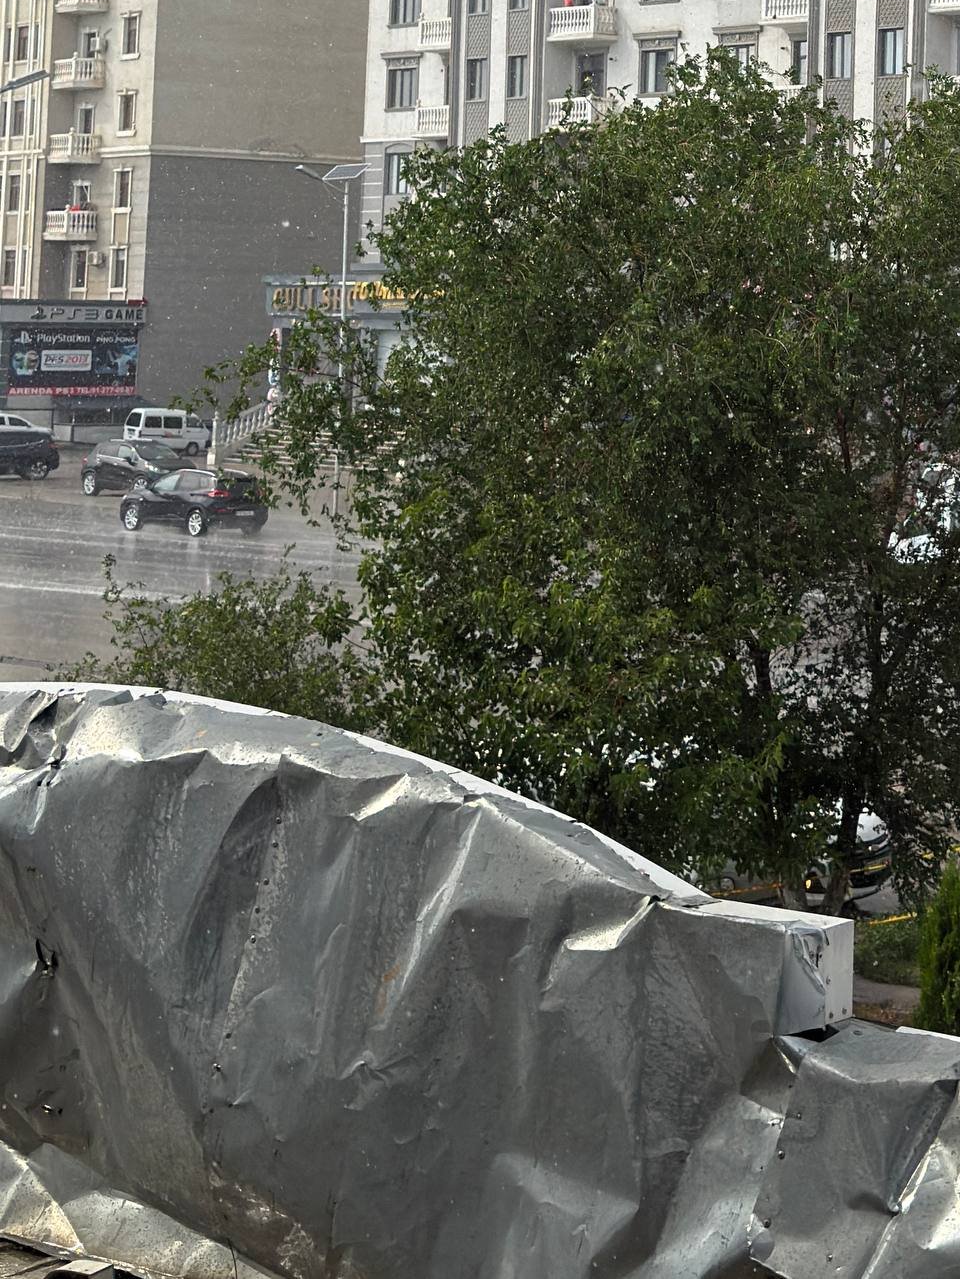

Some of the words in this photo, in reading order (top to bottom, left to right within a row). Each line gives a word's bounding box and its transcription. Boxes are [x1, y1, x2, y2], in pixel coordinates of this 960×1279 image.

[104, 308, 143, 321] GAME
[37, 332, 91, 345] PlayStation
[8, 387, 53, 395] ARENDA
